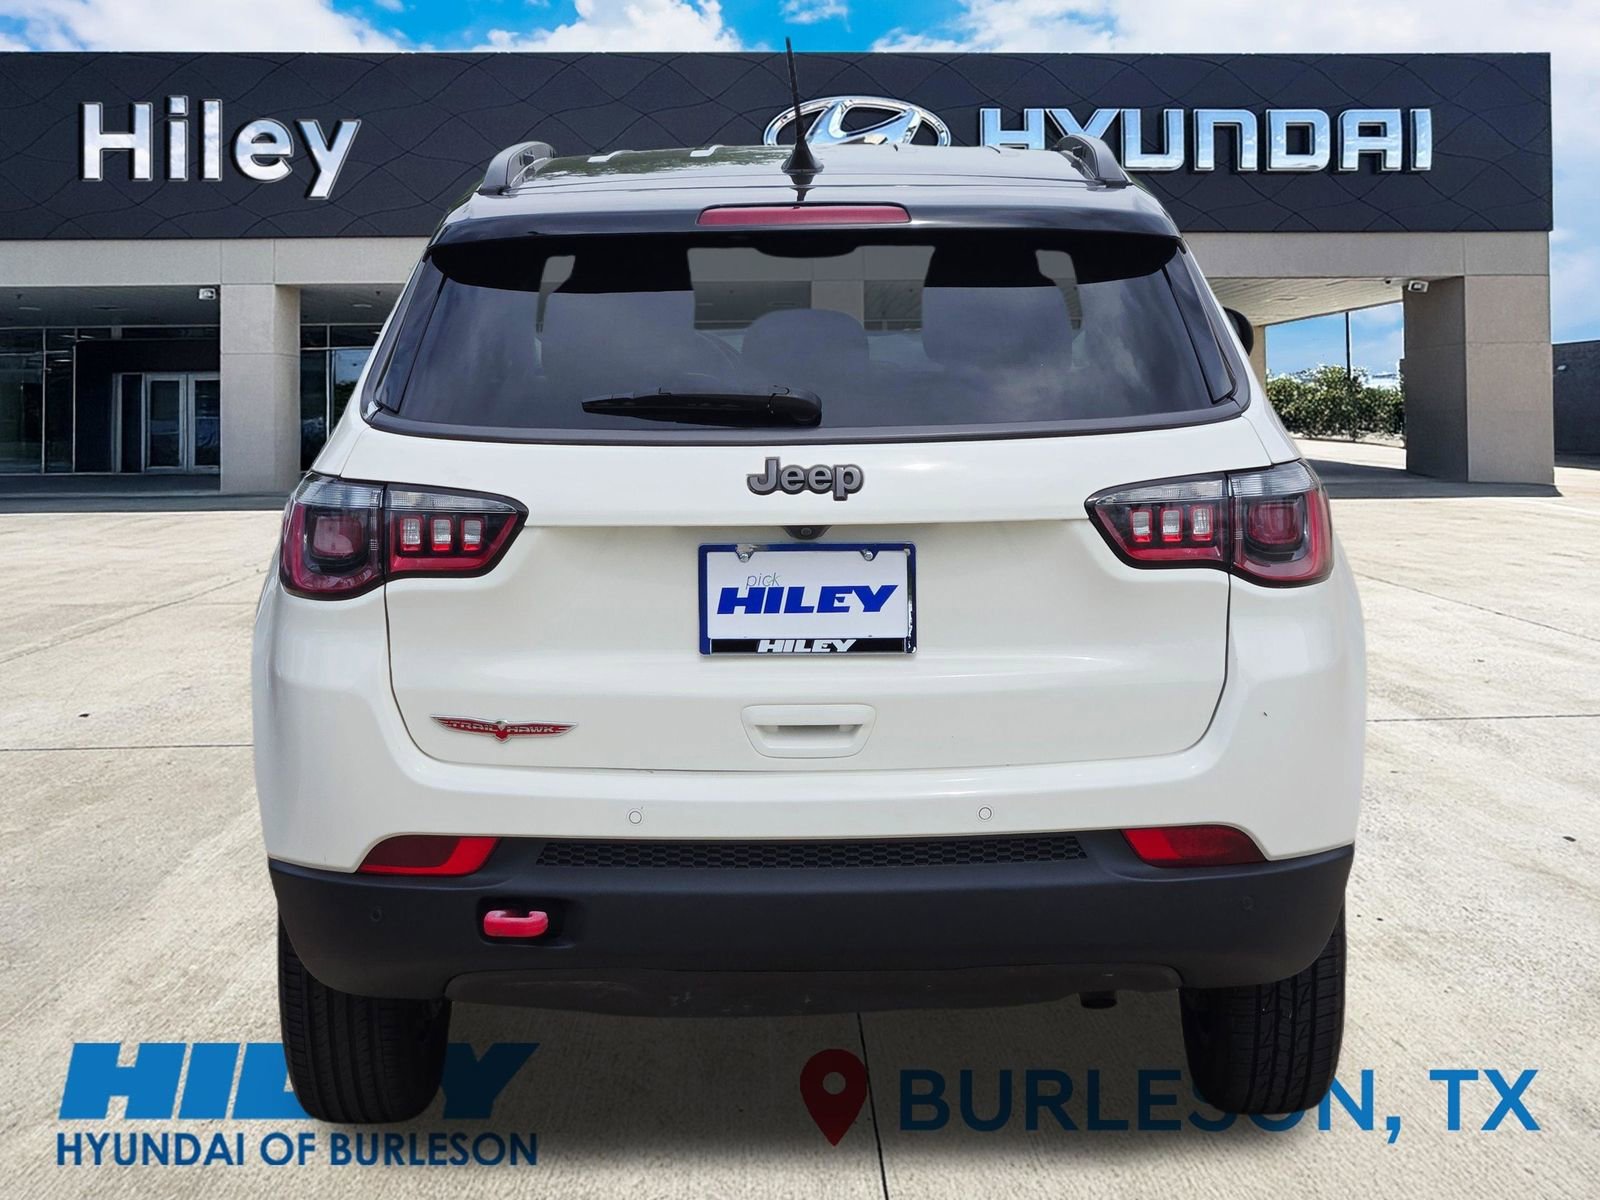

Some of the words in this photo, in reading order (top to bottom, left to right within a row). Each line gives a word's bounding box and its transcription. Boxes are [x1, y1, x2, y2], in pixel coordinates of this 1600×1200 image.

[81, 95, 361, 200] Hiley
[747, 457, 864, 501] Jeep
[745, 573, 781, 590] pick
[717, 585, 898, 615] HILEY
[757, 639, 857, 653] HILEY
